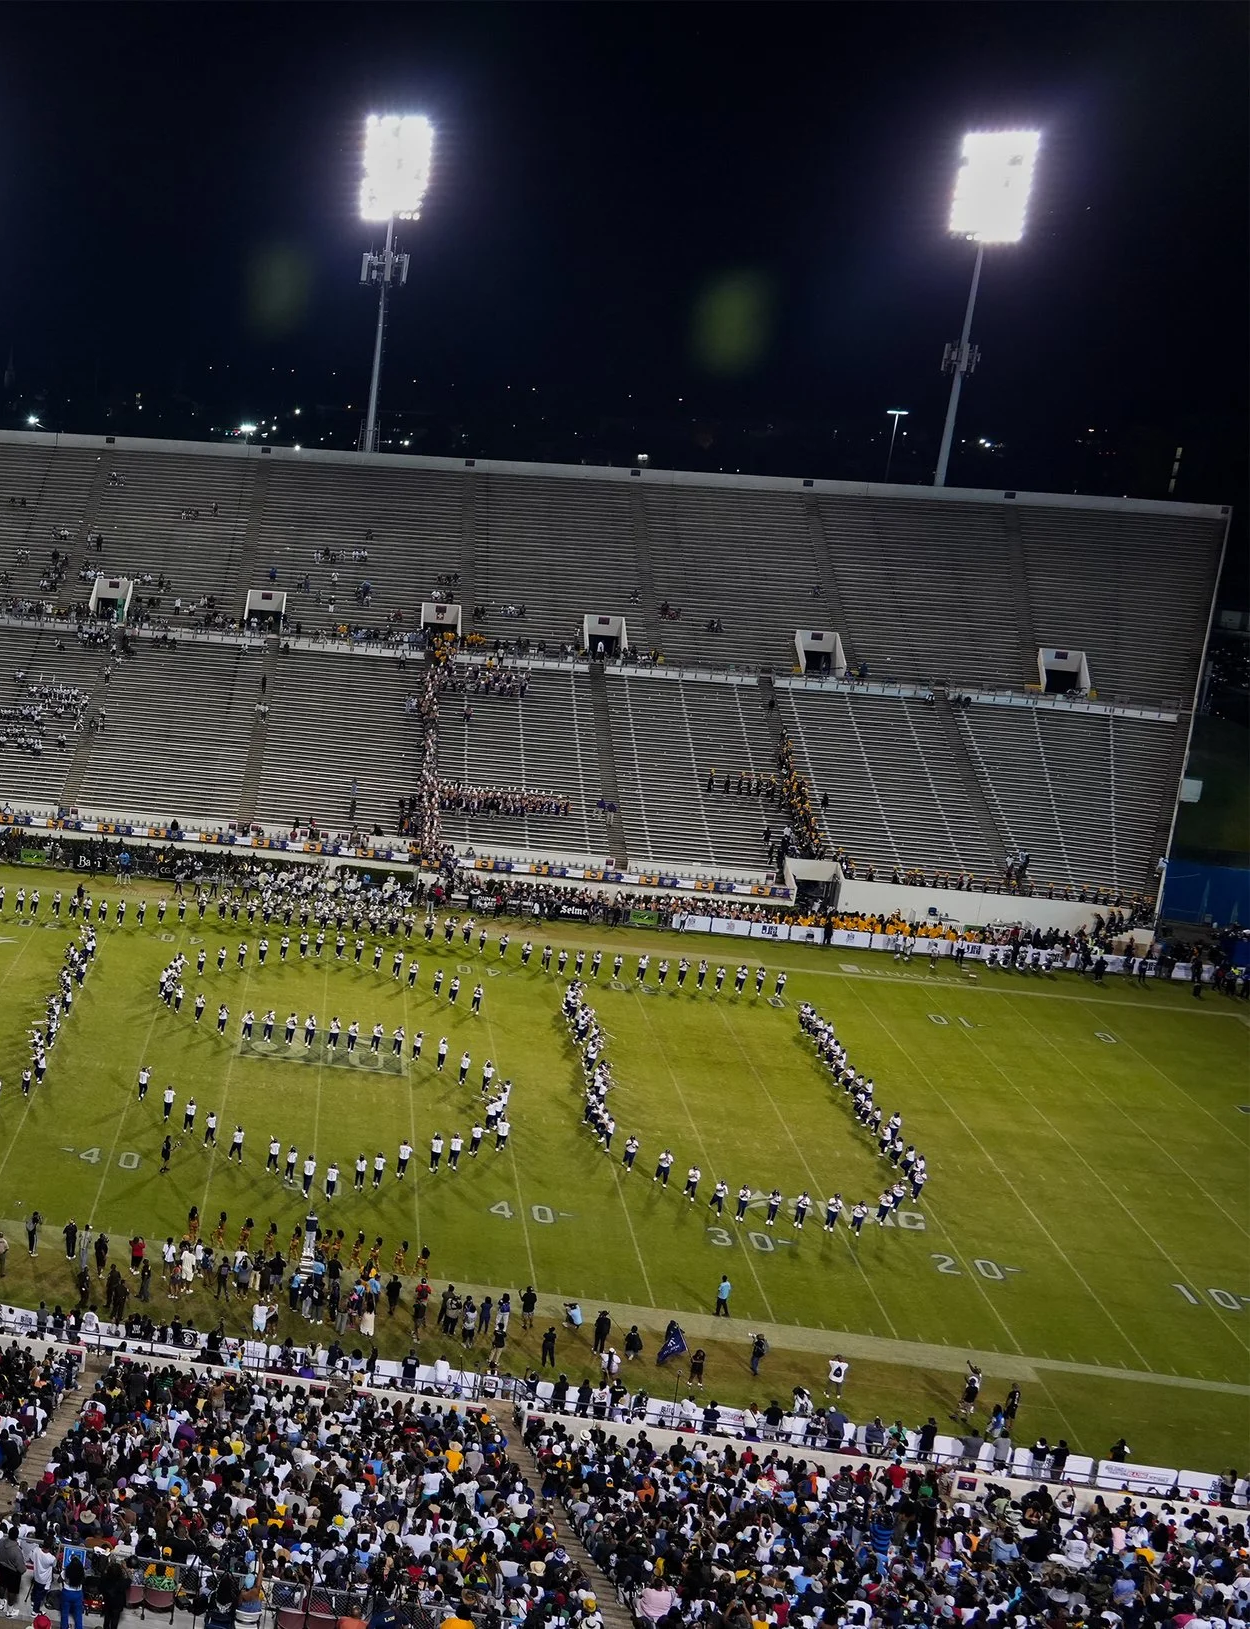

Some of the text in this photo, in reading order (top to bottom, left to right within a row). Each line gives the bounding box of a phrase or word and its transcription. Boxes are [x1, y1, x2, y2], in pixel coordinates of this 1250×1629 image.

[560, 902, 589, 916] Selme
[926, 1013, 975, 1029] 10
[79, 1146, 142, 1171] 40
[488, 1200, 555, 1224] 40
[707, 1226, 775, 1251] 30
[931, 1253, 1005, 1280] 20
[1171, 1283, 1243, 1310] 10
